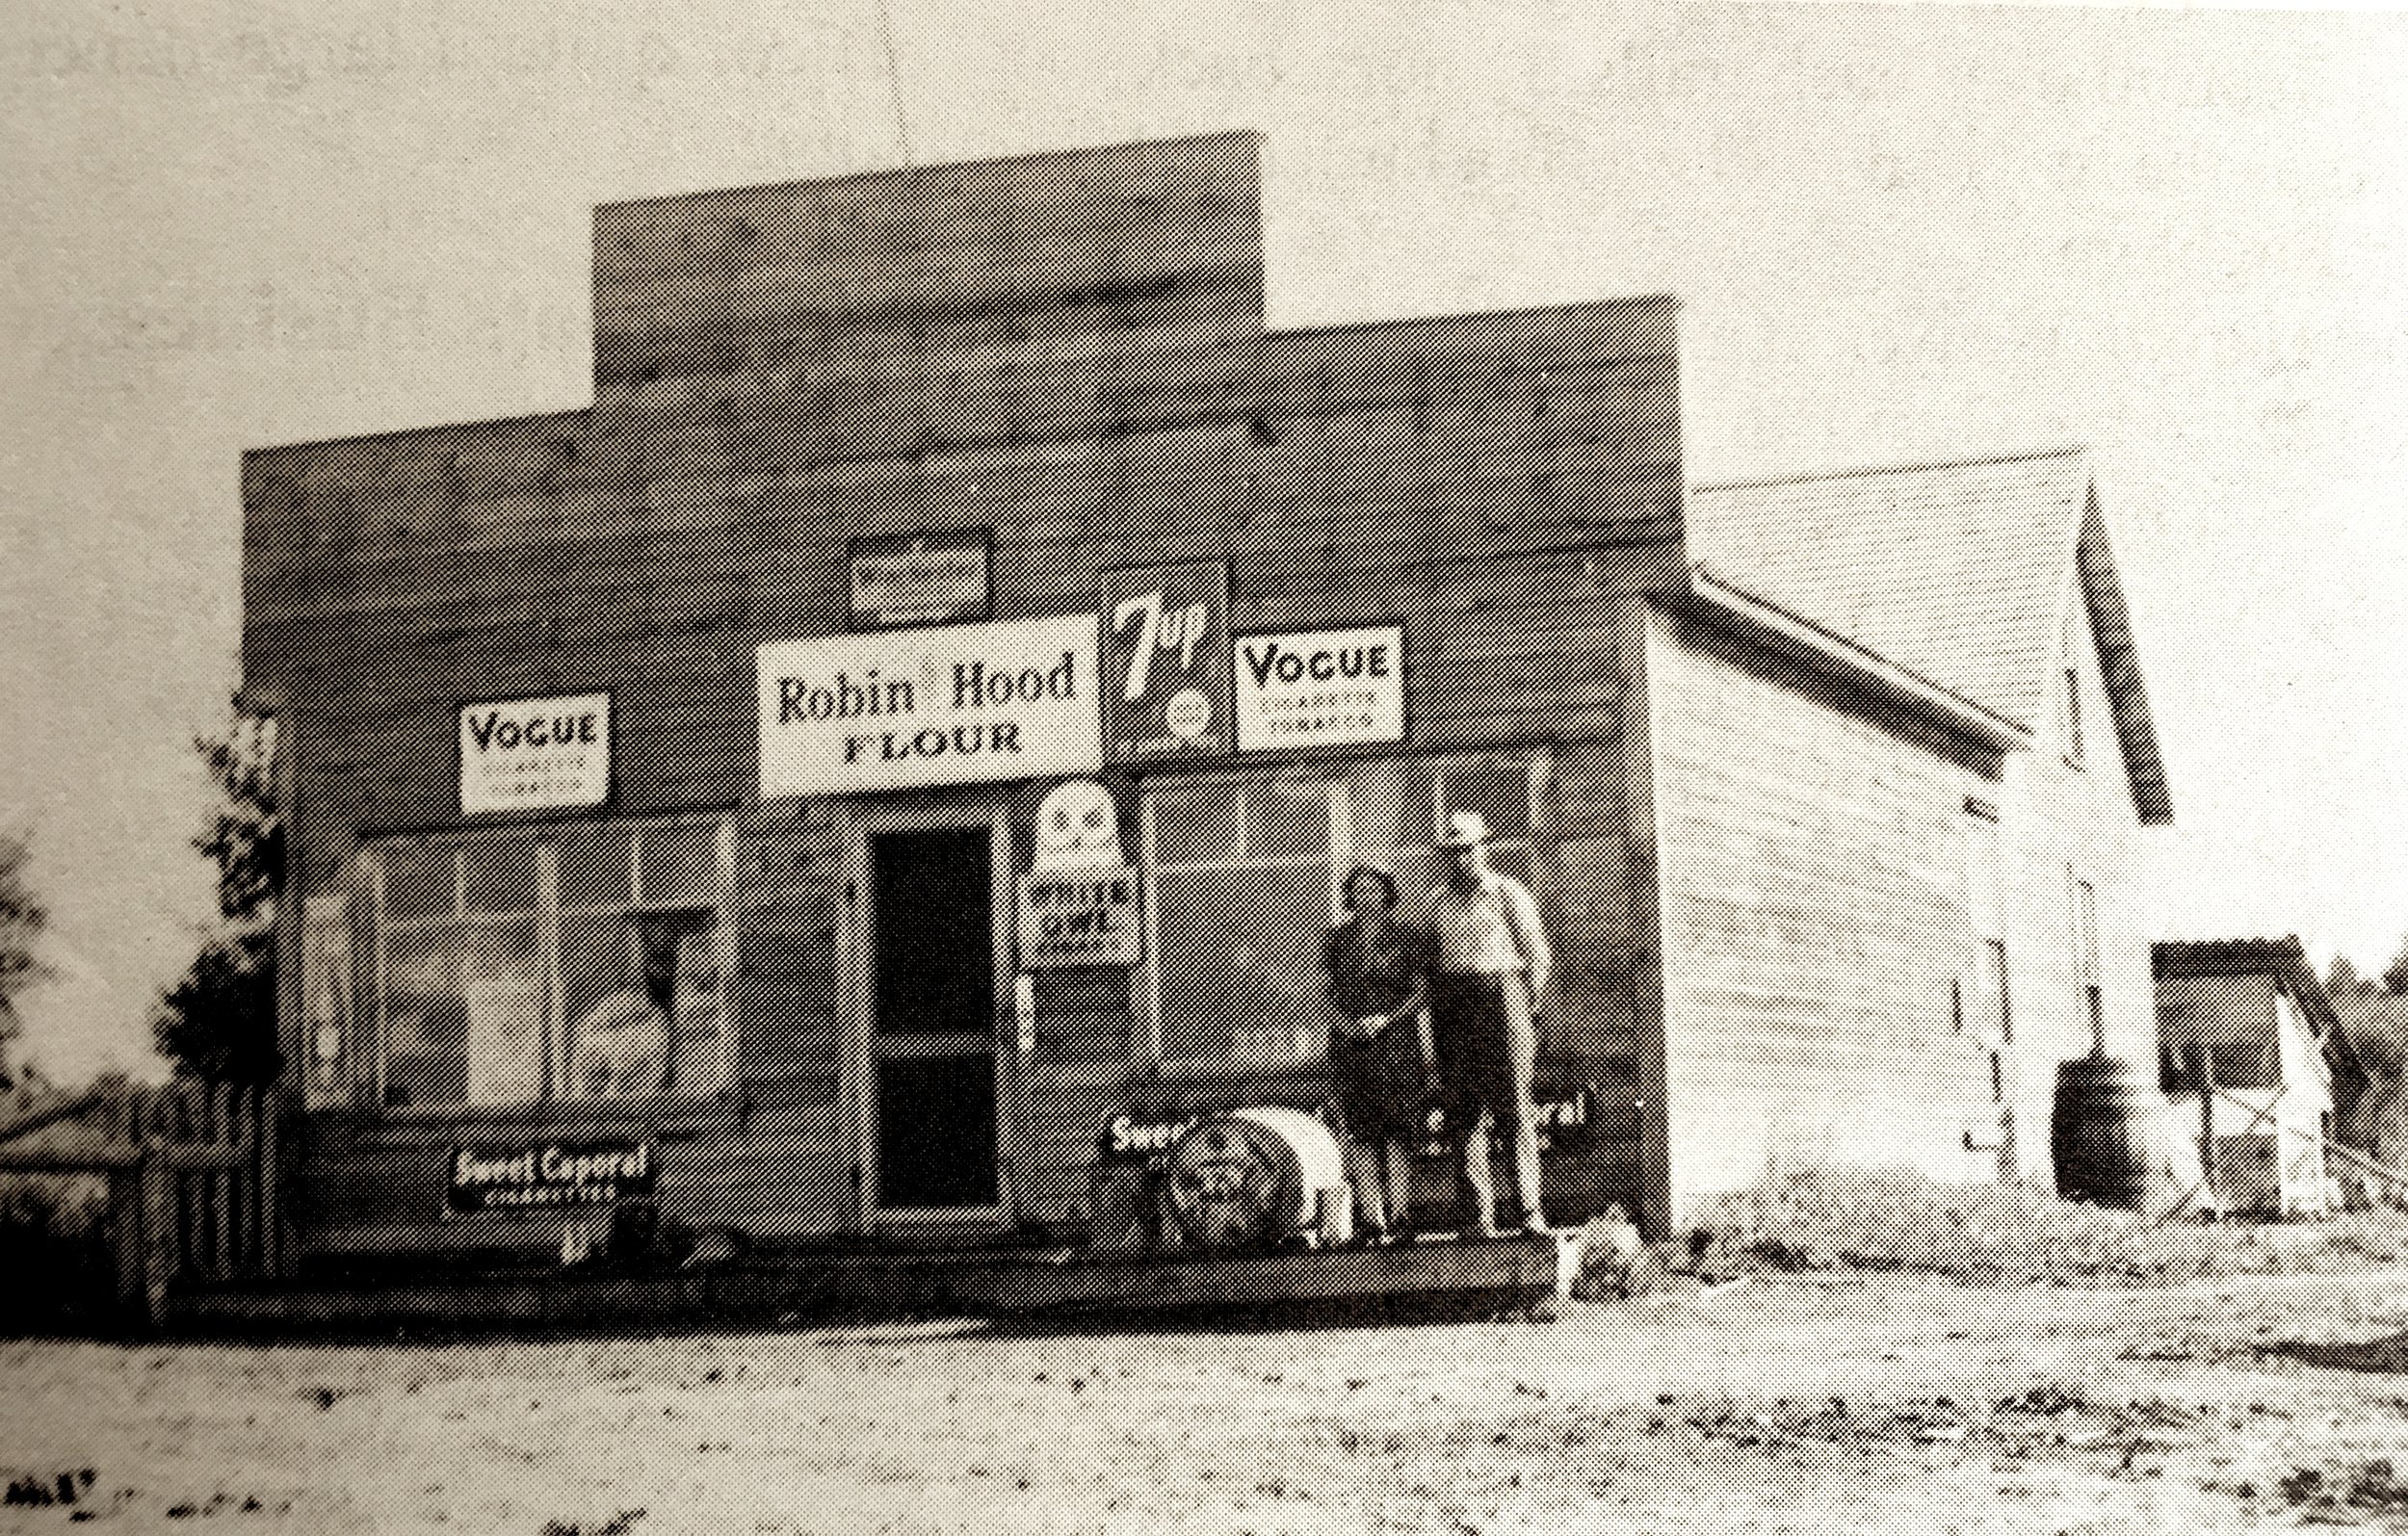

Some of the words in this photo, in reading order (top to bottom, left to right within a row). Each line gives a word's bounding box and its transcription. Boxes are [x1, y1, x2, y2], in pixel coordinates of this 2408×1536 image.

[776, 668, 916, 724] Robin
[952, 650, 1076, 709] Hood
[1243, 642, 1389, 690] VOGUE
[467, 711, 599, 753] VOGUE
[843, 722, 1022, 765] FLOUR
[1030, 877, 1130, 908] WHITE
[1040, 910, 1120, 938] OWL
[1111, 1114, 1198, 1151] Swee
[455, 1149, 537, 1186] Sweet
[540, 1142, 648, 1186] Caporal
